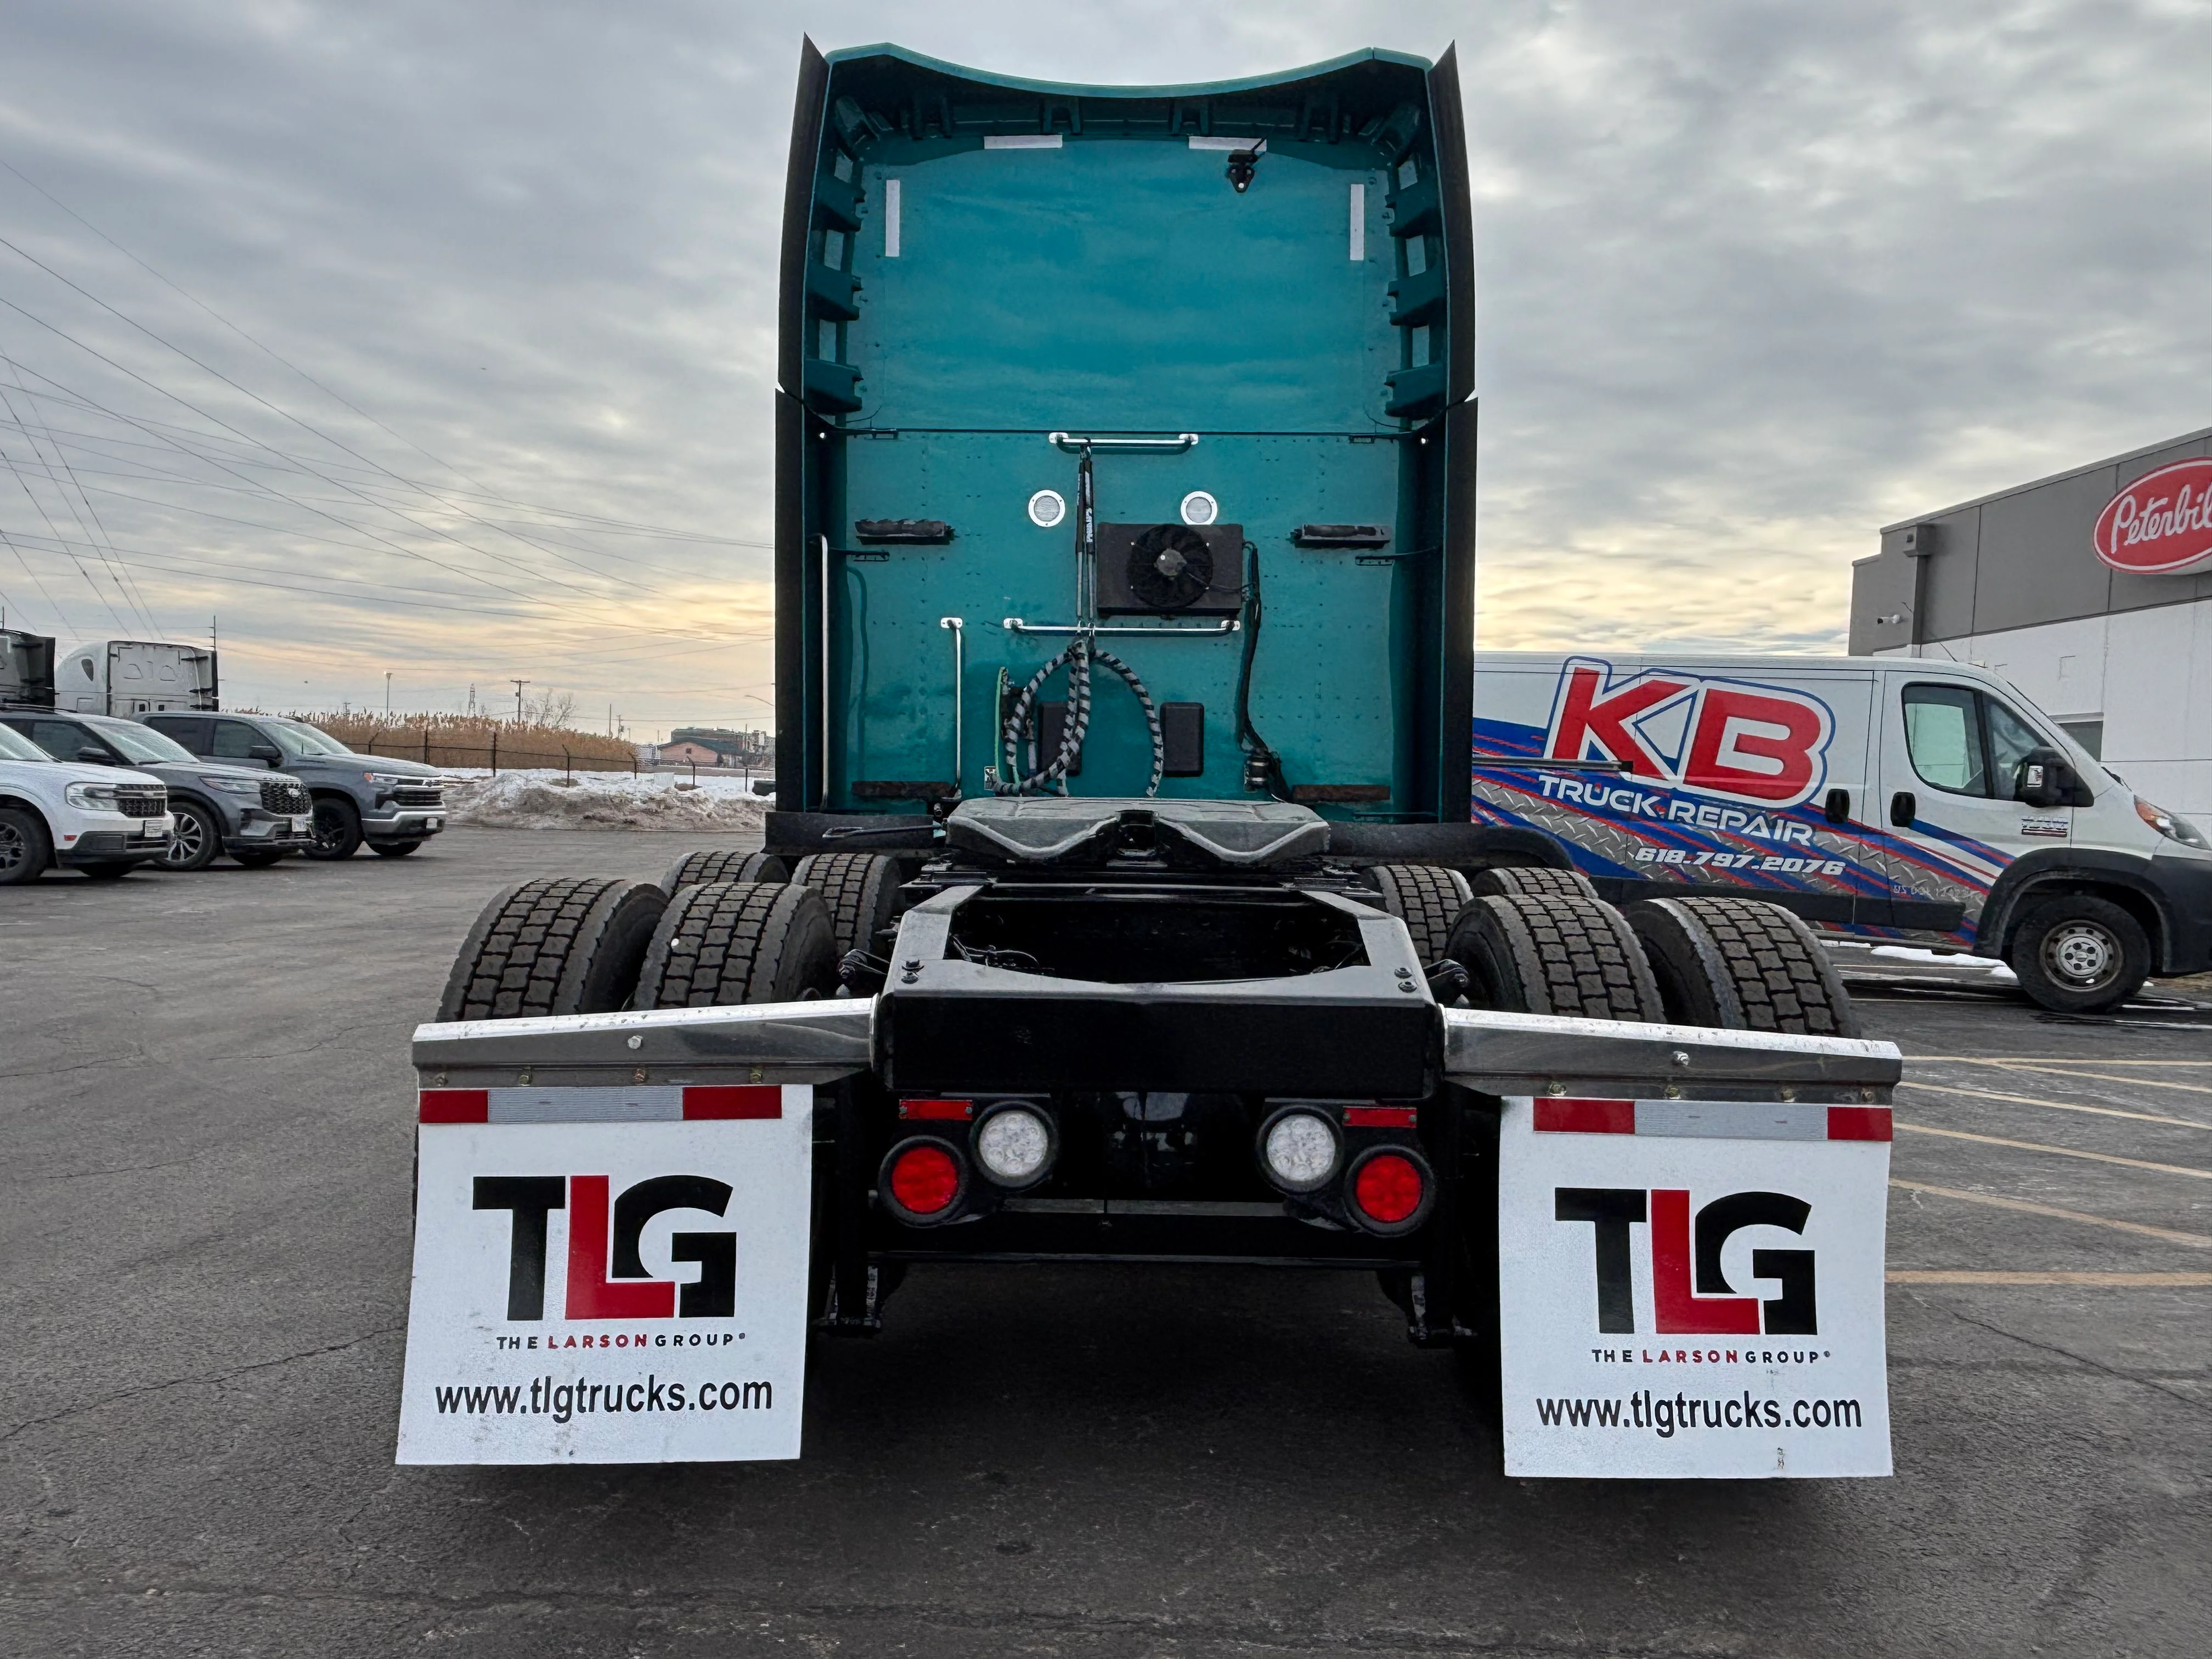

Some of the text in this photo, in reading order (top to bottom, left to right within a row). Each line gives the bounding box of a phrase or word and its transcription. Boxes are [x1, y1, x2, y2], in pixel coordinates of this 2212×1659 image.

[2111, 483, 2212, 554] Peterbil
[1551, 666, 1821, 801] KB
[1537, 775, 1816, 847] TRUCK REPAIR
[1634, 848, 1846, 876] 618.797.2076
[472, 1175, 737, 1321] TLG
[1555, 1187, 1818, 1335] TLG
[496, 1336, 538, 1350] THE
[548, 1334, 647, 1350] LARSON
[1592, 1348, 1633, 1363] THE
[1643, 1350, 1738, 1363] LARSON
[435, 1374, 772, 1423] www.tlgtrucks.com
[1536, 1390, 1862, 1438] www.tlgtrucks.com
